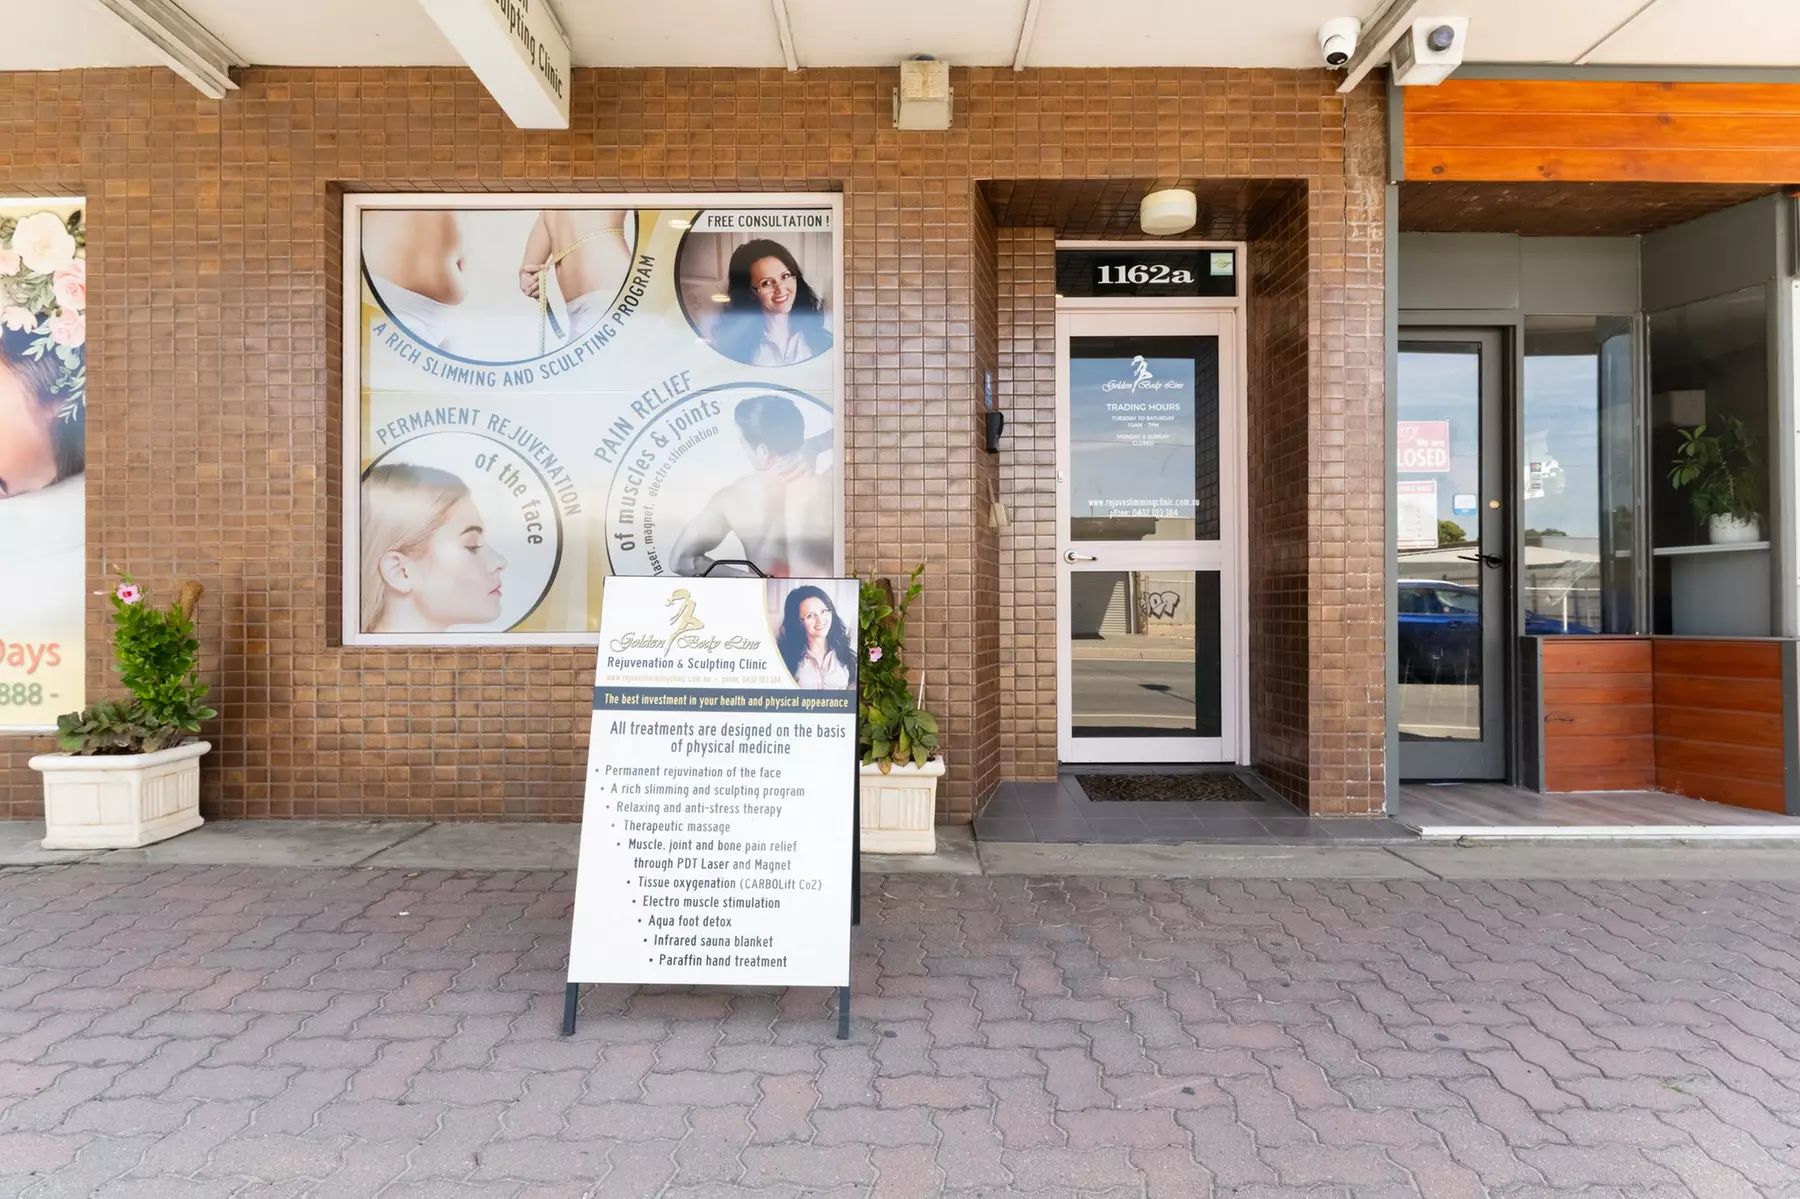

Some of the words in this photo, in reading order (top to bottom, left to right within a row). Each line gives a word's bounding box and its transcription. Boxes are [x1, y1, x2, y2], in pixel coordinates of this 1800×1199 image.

[496, 0, 535, 66] ulpting
[539, 43, 563, 99] Clinic
[707, 215, 734, 227] FREE
[738, 215, 823, 227] CONSULTATION
[1097, 264, 1195, 284] 1162a
[373, 322, 388, 337] A
[385, 333, 422, 364] RICH
[422, 356, 497, 387] SLIMMING
[503, 369, 534, 386] AND
[541, 324, 617, 379] SCULPTING
[612, 254, 655, 328] PROGRAM
[1101, 380, 1132, 392] Golden
[1138, 380, 1163, 392] Body
[1164, 380, 1185, 390] Line
[1106, 403, 1147, 411] TRADING
[1149, 403, 1181, 411] HOURS
[593, 415, 634, 464] PAIN
[630, 370, 693, 420] RELIEF
[665, 398, 721, 441] joints
[650, 430, 670, 449] &
[1416, 439, 1429, 447] We
[376, 407, 481, 445] PERMANENT
[486, 413, 582, 517] REJUVENATION
[648, 462, 671, 497] electro
[668, 426, 719, 463] stimulation
[618, 449, 656, 524] muscles
[475, 453, 499, 473] of
[498, 463, 528, 498] the
[521, 498, 544, 545] face
[1131, 508, 1149, 516] 0432
[614, 532, 636, 552] of
[609, 632, 666, 653] Golden
[677, 634, 722, 653] Body
[724, 635, 762, 650] Line
[607, 656, 674, 671] Rejuvenation
[677, 660, 684, 668] &
[688, 657, 736, 672] Sculpting
[739, 658, 768, 670] Clinic
[604, 693, 619, 705] The
[621, 693, 639, 705] best
[641, 694, 687, 706] investment
[689, 695, 697, 705] in
[699, 697, 717, 709] your
[720, 695, 746, 706] health
[748, 695, 763, 706] and
[765, 696, 799, 710] physical
[801, 698, 848, 710] appearance
[610, 721, 626, 735] All
[630, 722, 694, 736] treatments
[698, 725, 717, 736] are
[721, 723, 772, 740] designed
[776, 726, 790, 737] on
[794, 724, 812, 738] the
[817, 724, 846, 738] basis
[670, 739, 683, 753] of
[686, 739, 735, 757] physical
[738, 740, 791, 754] medicine
[605, 765, 660, 777] Permanent
[663, 766, 723, 780] rejuvination
[726, 766, 737, 778] of
[739, 767, 756, 778] the
[759, 767, 781, 778] face
[610, 783, 618, 794] A
[621, 783, 641, 794] rich
[644, 783, 689, 798] slimming
[692, 784, 710, 795] and
[714, 785, 760, 799] sculpting
[763, 786, 805, 799] program
[616, 801, 660, 816] Relaxing
[663, 802, 681, 813] and
[685, 802, 740, 814] anti-stress
[743, 803, 782, 818] therapy
[624, 820, 684, 834] Therapeutic
[687, 823, 731, 838] massage
[669, 839, 692, 853] joint
[696, 840, 714, 851] and
[717, 840, 742, 852] bone
[745, 840, 767, 854] pain
[770, 841, 797, 852] relief
[634, 858, 673, 872] through
[677, 858, 698, 869] PDT
[701, 858, 730, 870] Laser
[732, 859, 751, 870] and
[754, 859, 791, 873] Magnet
[638, 876, 670, 888] Tissue
[673, 877, 736, 891] oxygenation
[739, 878, 796, 890] (CARBOLift
[798, 879, 822, 891] Co2)
[642, 895, 680, 907] Electro
[683, 896, 719, 908] muscle
[722, 896, 780, 908] stimulation
[648, 915, 675, 929] Aqua
[678, 915, 700, 927] foot
[703, 915, 732, 928] detox
[654, 934, 697, 947] Infrared
[700, 936, 730, 947] sauna
[734, 935, 773, 948] blanket
[659, 954, 702, 966] Paraffin
[705, 954, 731, 967] hand
[734, 955, 787, 968] treatment
